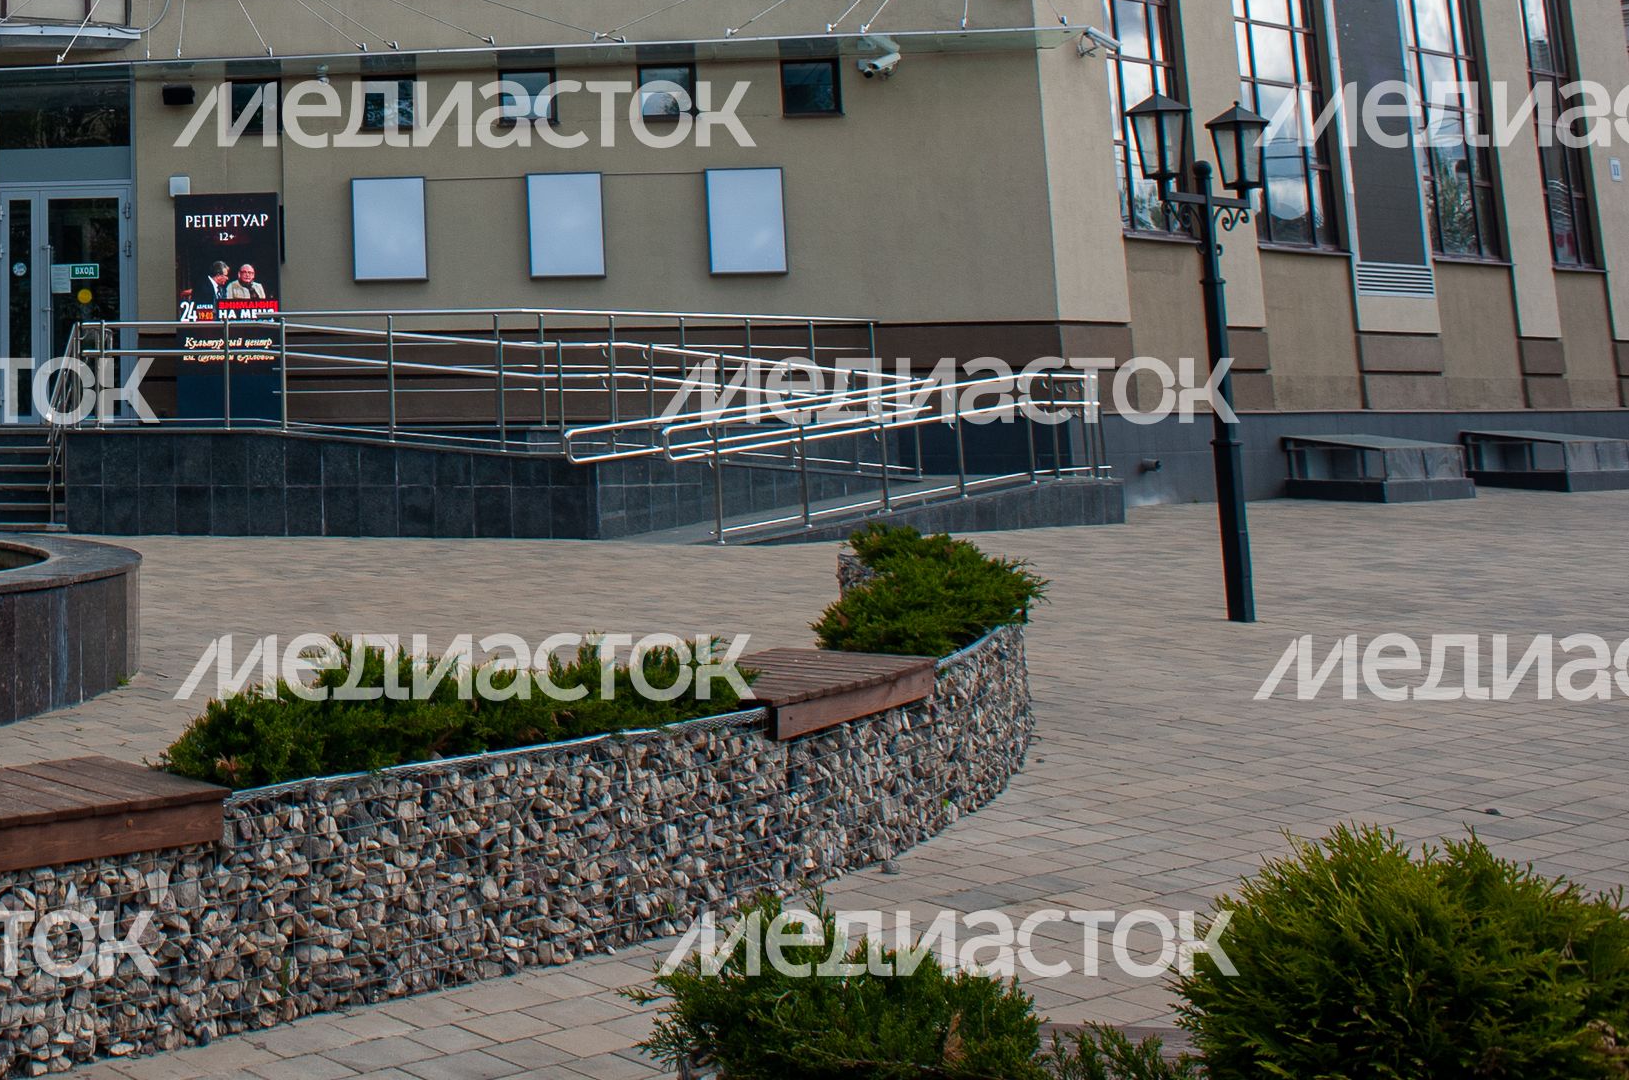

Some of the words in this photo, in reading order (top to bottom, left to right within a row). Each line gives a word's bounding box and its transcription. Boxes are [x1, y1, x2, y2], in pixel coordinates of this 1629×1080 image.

[185, 214, 269, 228] РЕПЕРТУАР
[219, 232, 235, 241] 12+
[75, 267, 94, 275] ВХОД
[180, 301, 198, 322] 24
[219, 309, 237, 319] НА
[184, 337, 242, 349] Культурый
